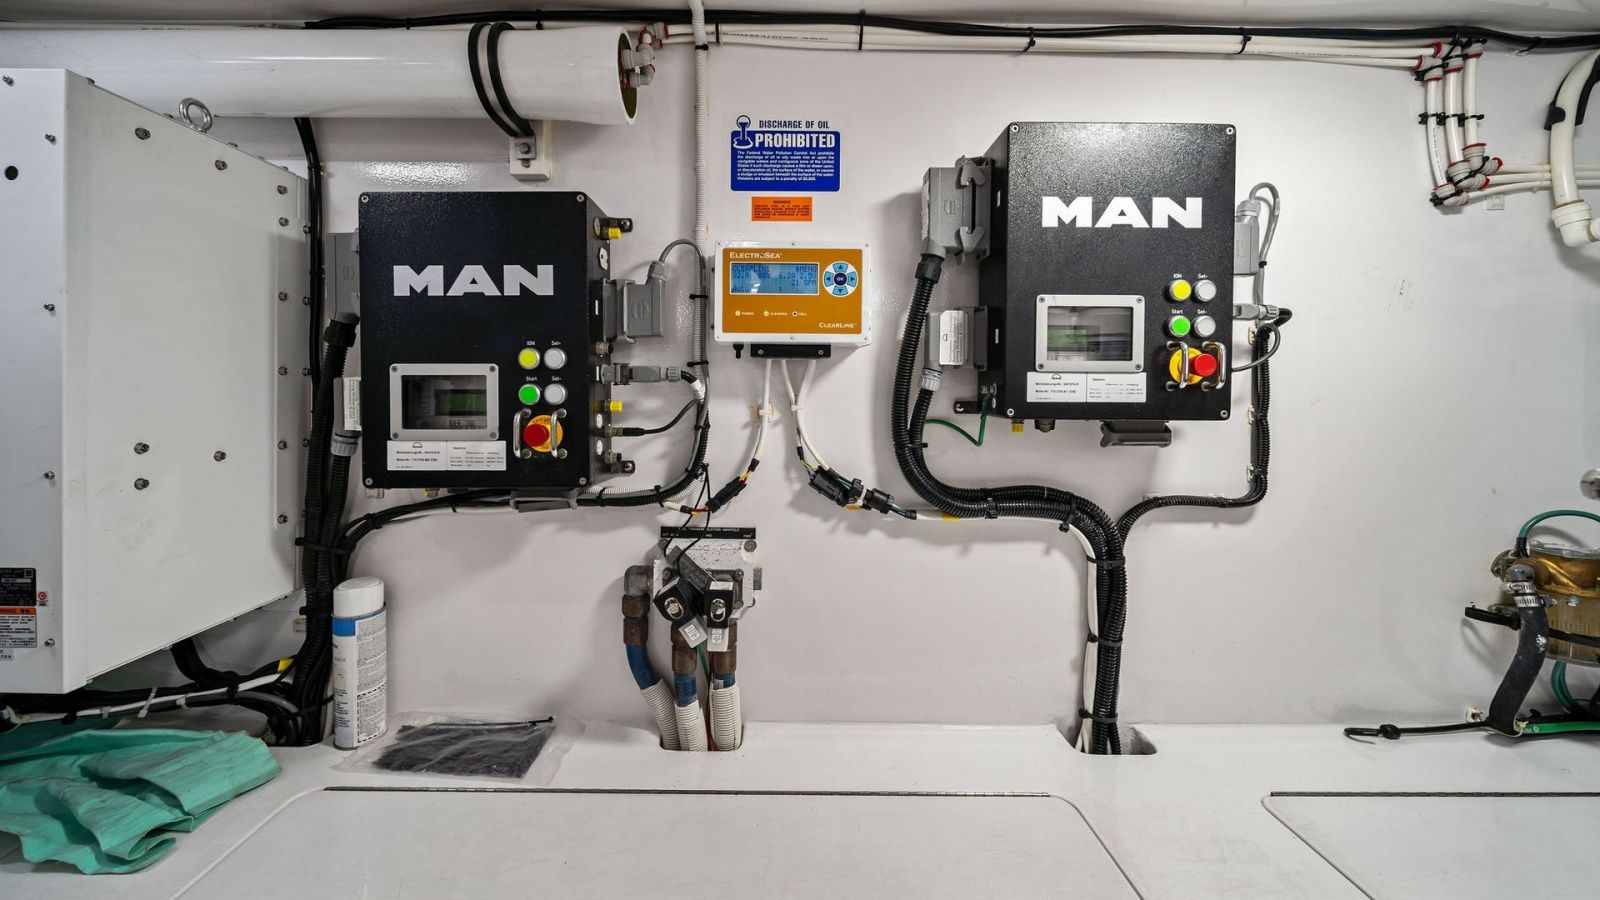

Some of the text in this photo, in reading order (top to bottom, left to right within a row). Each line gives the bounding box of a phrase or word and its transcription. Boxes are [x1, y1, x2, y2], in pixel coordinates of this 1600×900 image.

[759, 120, 830, 129] DISCHARGE OF OIL
[755, 134, 835, 148] PROHIBITED
[1042, 197, 1202, 228] MAN
[393, 265, 553, 296] MAN
